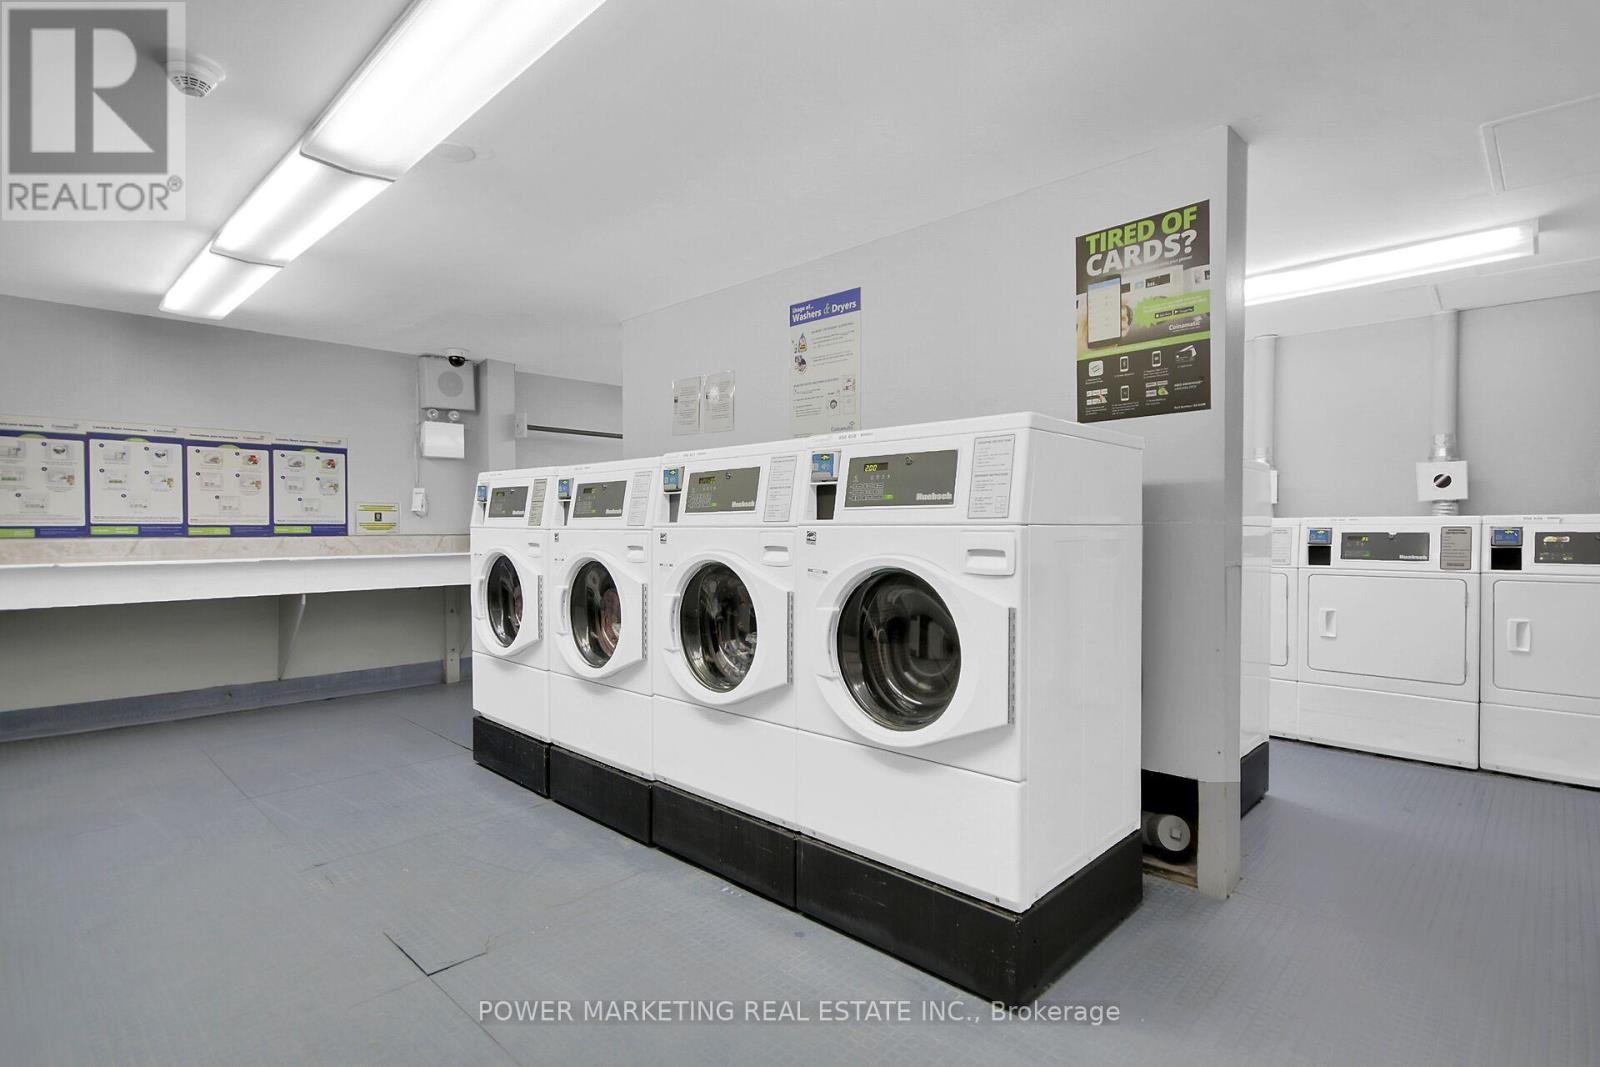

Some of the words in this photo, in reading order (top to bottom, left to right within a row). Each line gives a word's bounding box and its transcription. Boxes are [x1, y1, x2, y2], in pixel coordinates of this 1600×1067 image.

[1086, 220, 1155, 255] TIRED
[1161, 206, 1197, 232] OF
[1086, 229, 1198, 277] CARDS?
[792, 309, 822, 323] Washers
[823, 302, 831, 315] &
[832, 301, 857, 313] Dryers
